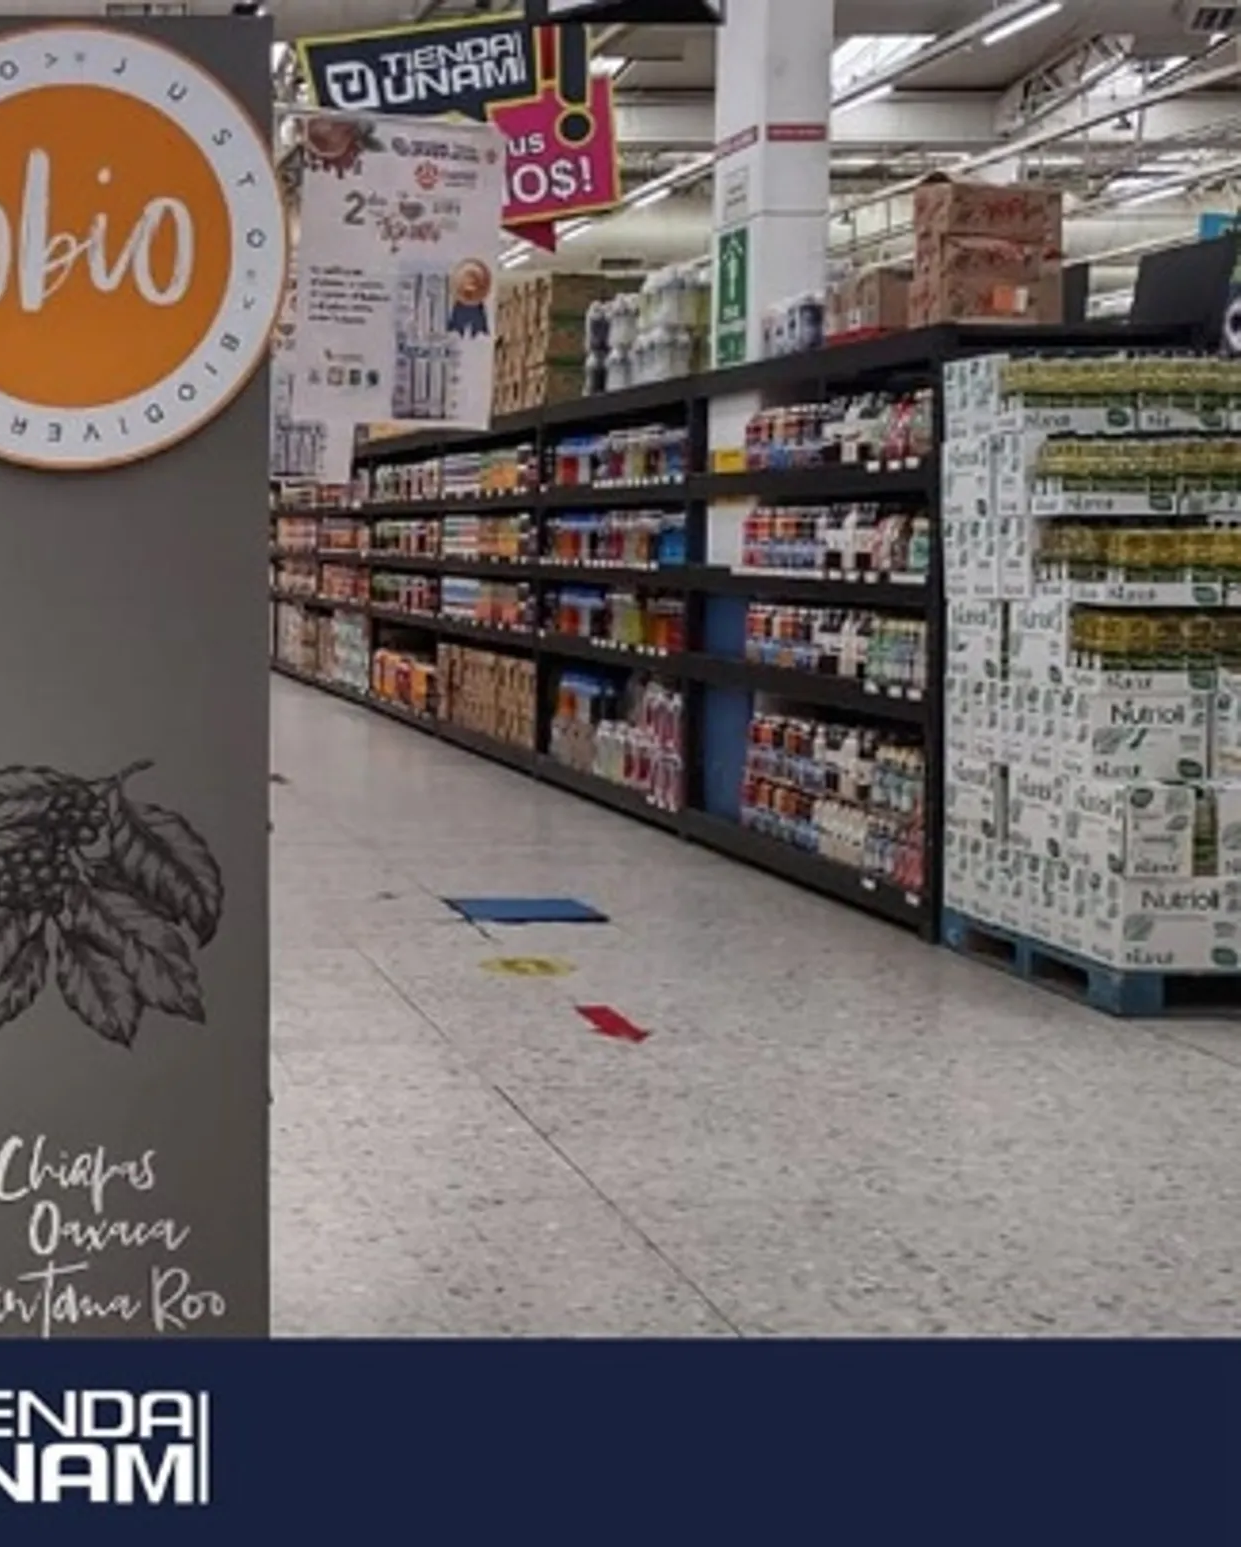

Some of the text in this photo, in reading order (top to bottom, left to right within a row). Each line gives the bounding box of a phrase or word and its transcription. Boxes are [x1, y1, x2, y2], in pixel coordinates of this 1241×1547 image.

[380, 32, 515, 76] TIENDA
[384, 56, 518, 104] UNAM
[112, 57, 267, 249] JUSTO
[28, 1200, 190, 1255] Oaxaca
[151, 1267, 226, 1332] Roo
